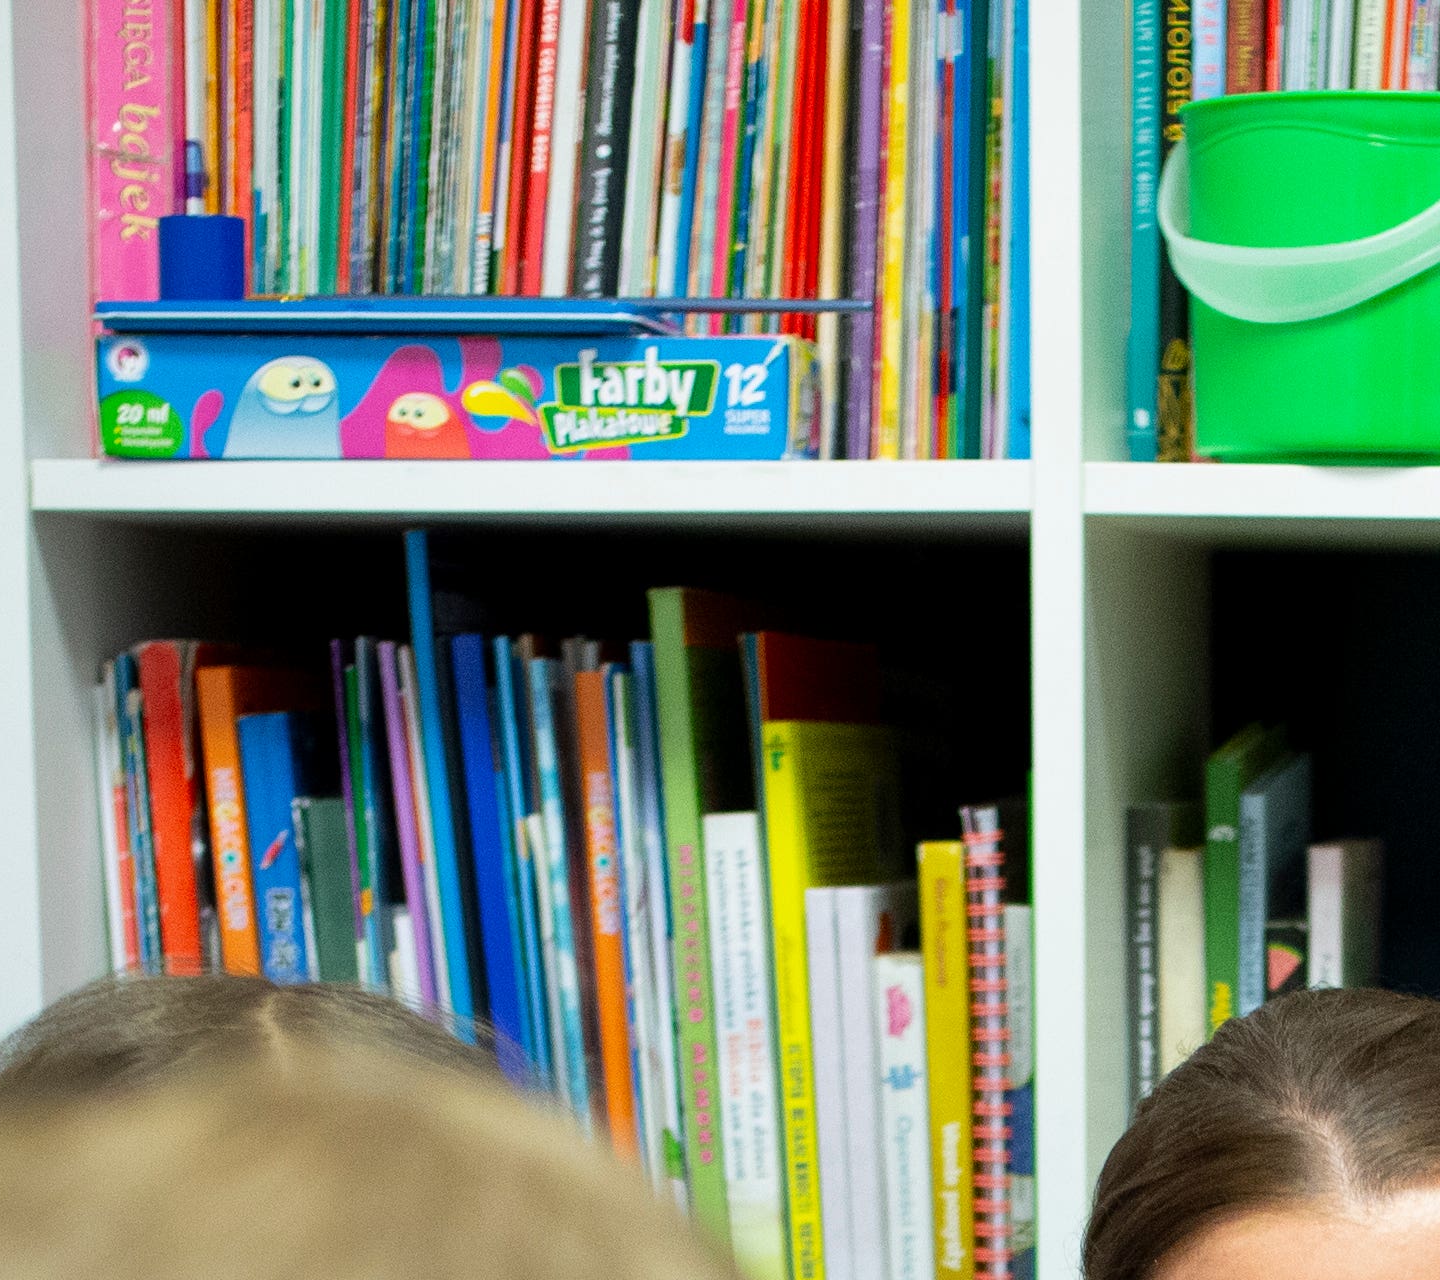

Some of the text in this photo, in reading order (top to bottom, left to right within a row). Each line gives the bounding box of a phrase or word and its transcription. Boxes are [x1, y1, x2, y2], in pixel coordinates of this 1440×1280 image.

[578, 346, 769, 417] Farby 12
[116, 402, 145, 424] 20
[553, 407, 673, 447] Plakatowe
[211, 766, 249, 932] MEGACOLOUR
